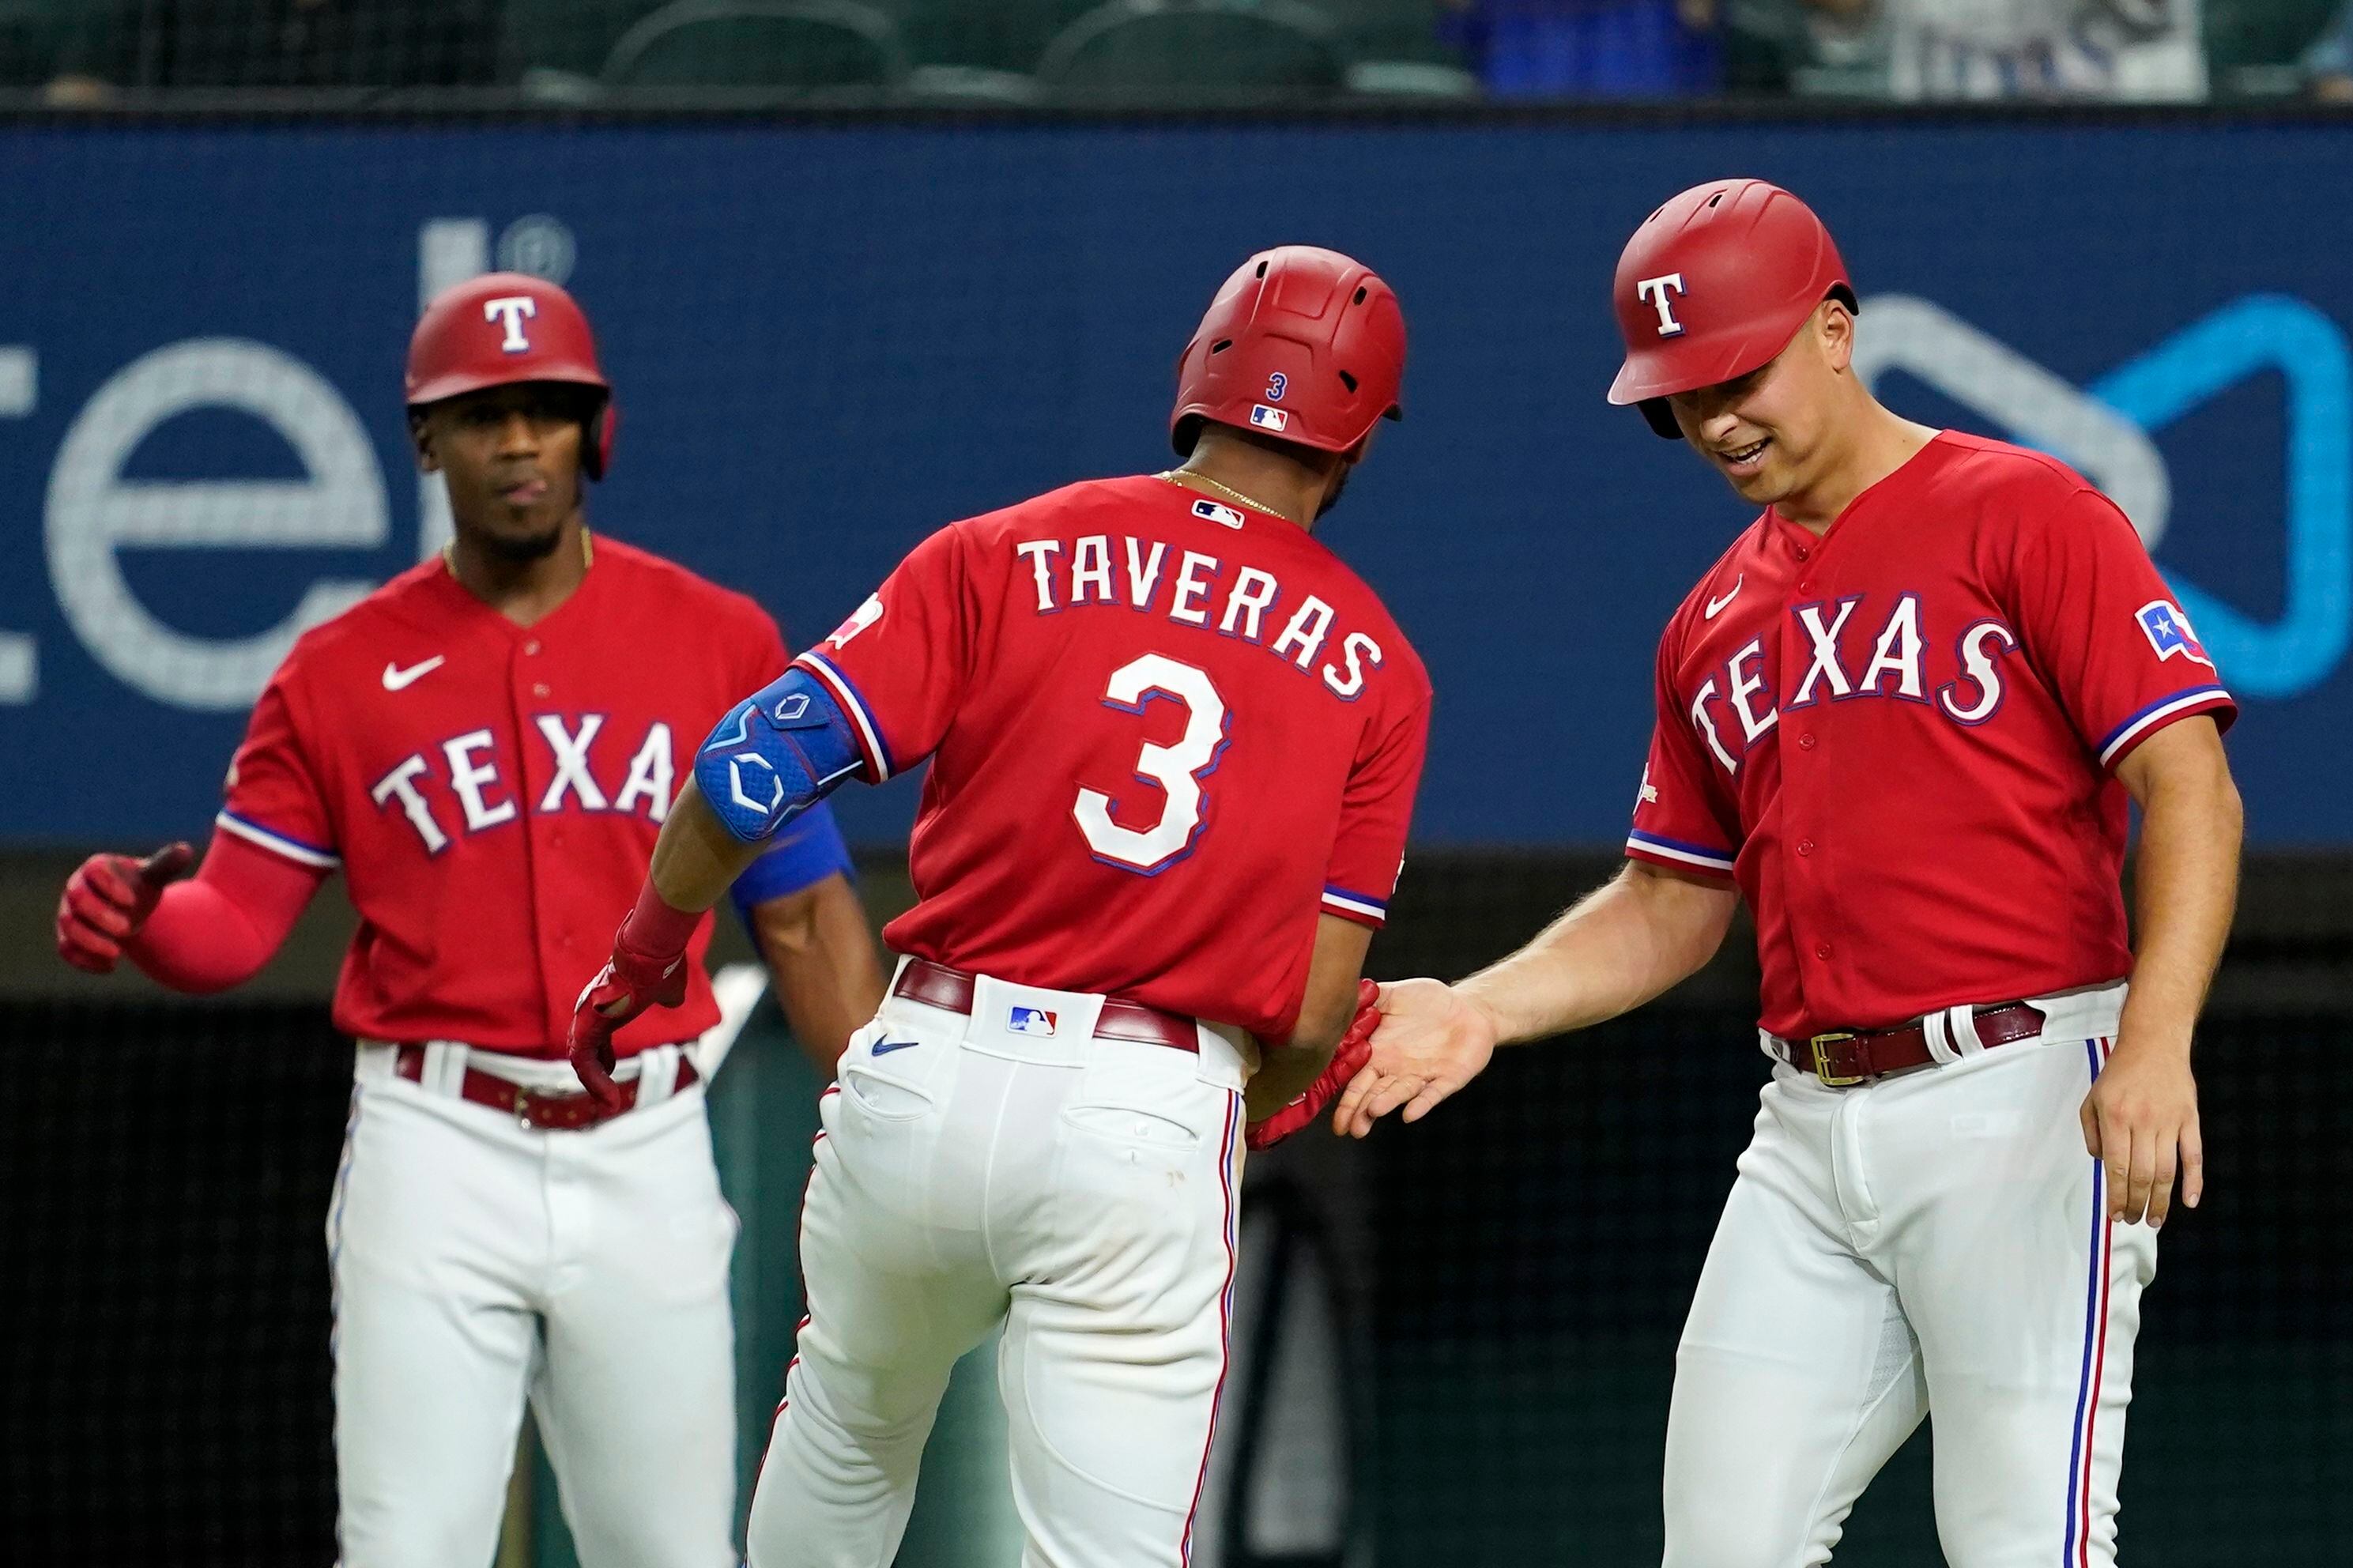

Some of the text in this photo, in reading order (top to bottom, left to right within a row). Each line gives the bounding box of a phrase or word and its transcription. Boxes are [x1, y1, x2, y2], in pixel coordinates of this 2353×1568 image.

[483, 296, 537, 354] T
[1637, 272, 1686, 337] T
[1265, 371, 1288, 402] 3
[1017, 534, 1385, 702] TAVERAS
[1689, 590, 2019, 777] TEXAS
[370, 711, 674, 858] TEXA
[1072, 652, 1233, 877] 3
